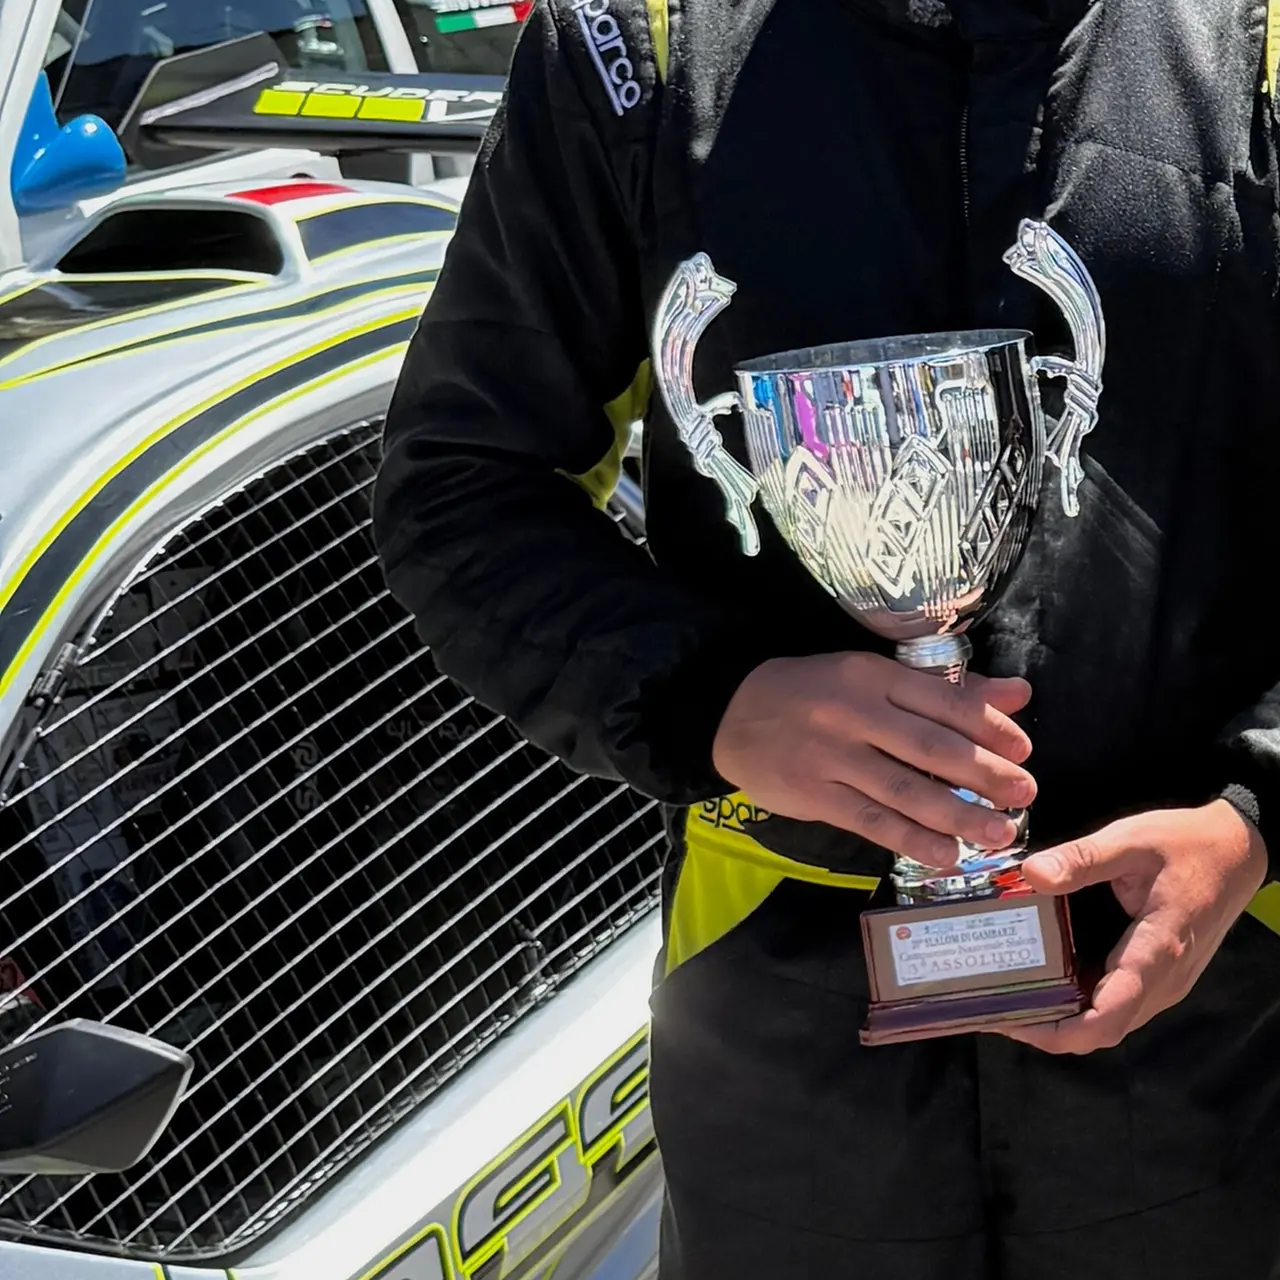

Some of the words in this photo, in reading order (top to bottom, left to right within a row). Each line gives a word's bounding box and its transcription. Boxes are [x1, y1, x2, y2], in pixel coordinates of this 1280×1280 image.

[272, 80, 504, 103] SCUDER
[699, 796, 772, 833] spar
[931, 947, 1032, 973] ASSOLUTO
